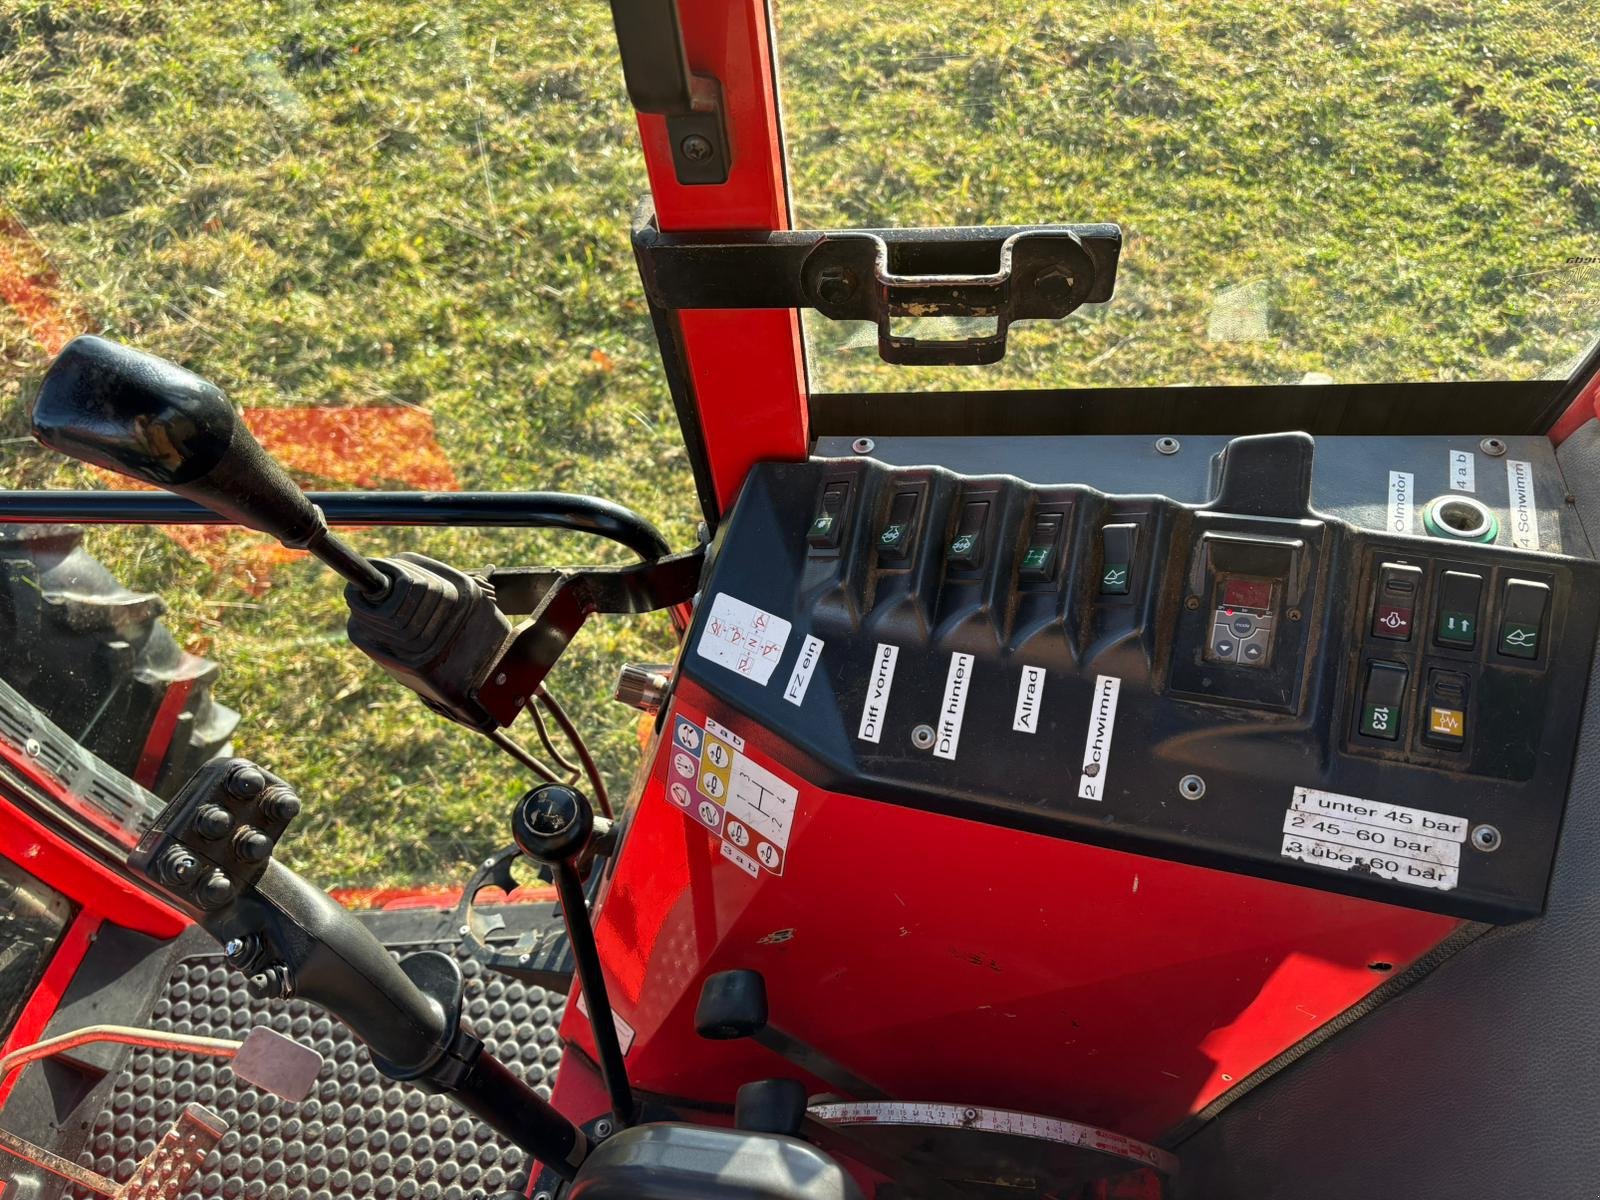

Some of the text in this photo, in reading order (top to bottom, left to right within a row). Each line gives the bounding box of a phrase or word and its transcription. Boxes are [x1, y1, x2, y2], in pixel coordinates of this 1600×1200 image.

[1456, 454, 1468, 490] 4 a b
[1514, 463, 1530, 533] Schwimm
[789, 641, 817, 699] FZ ein
[864, 646, 892, 739] Diff vorne
[939, 655, 967, 754] Diff hinten
[1018, 670, 1038, 729] Allrad
[1084, 678, 1113, 797] 2 chwimm
[1291, 816, 1305, 828] 2
[1393, 836, 1433, 853] bar
[1298, 794, 1461, 833] 1 unter 45 bar
[1289, 841, 1447, 882] 3 über 60 bar
